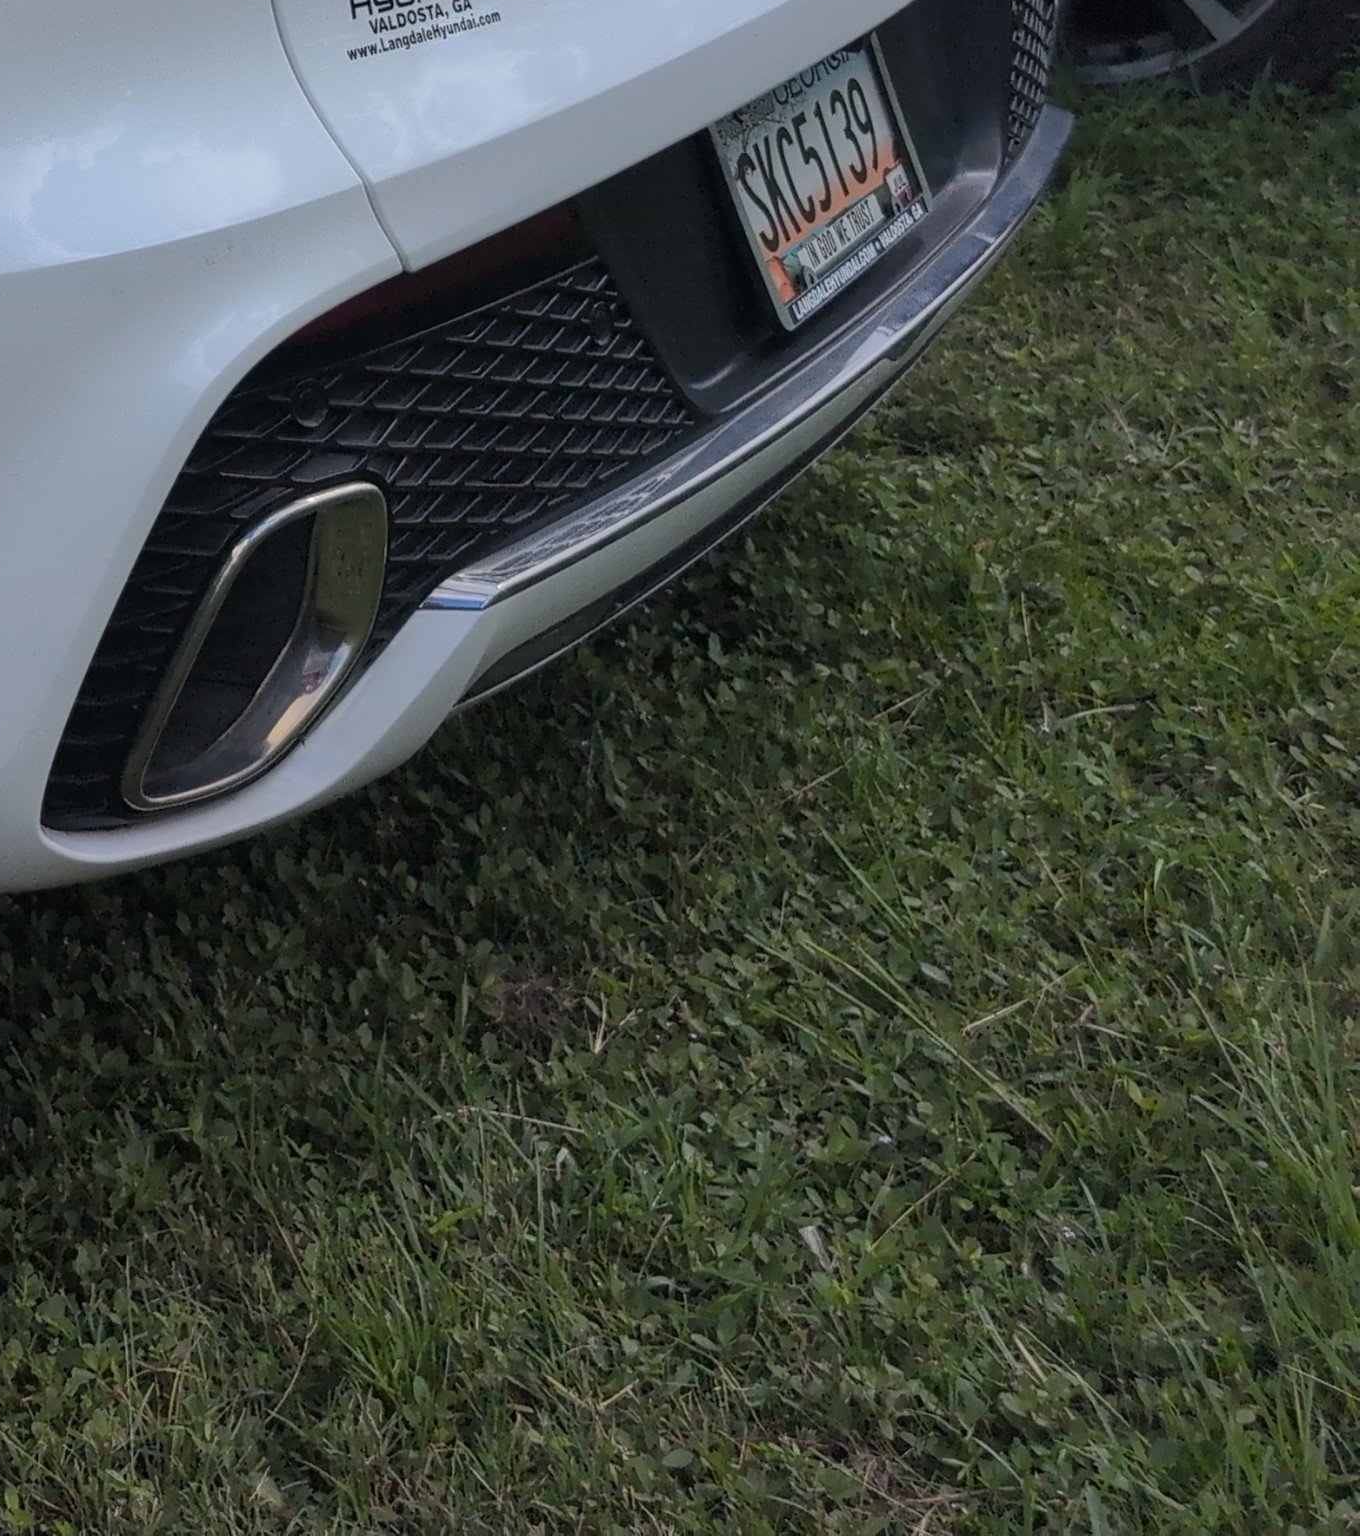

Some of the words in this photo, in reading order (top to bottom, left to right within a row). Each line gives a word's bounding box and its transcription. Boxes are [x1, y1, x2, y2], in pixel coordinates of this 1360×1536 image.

[346, 9, 502, 61] www.LangdaleHyundai.com
[369, 2, 451, 35] VALDOSTA,
[735, 76, 879, 253] SKC5139
[802, 242, 822, 270] IN
[833, 218, 851, 246] WE
[847, 198, 875, 236] TRUST
